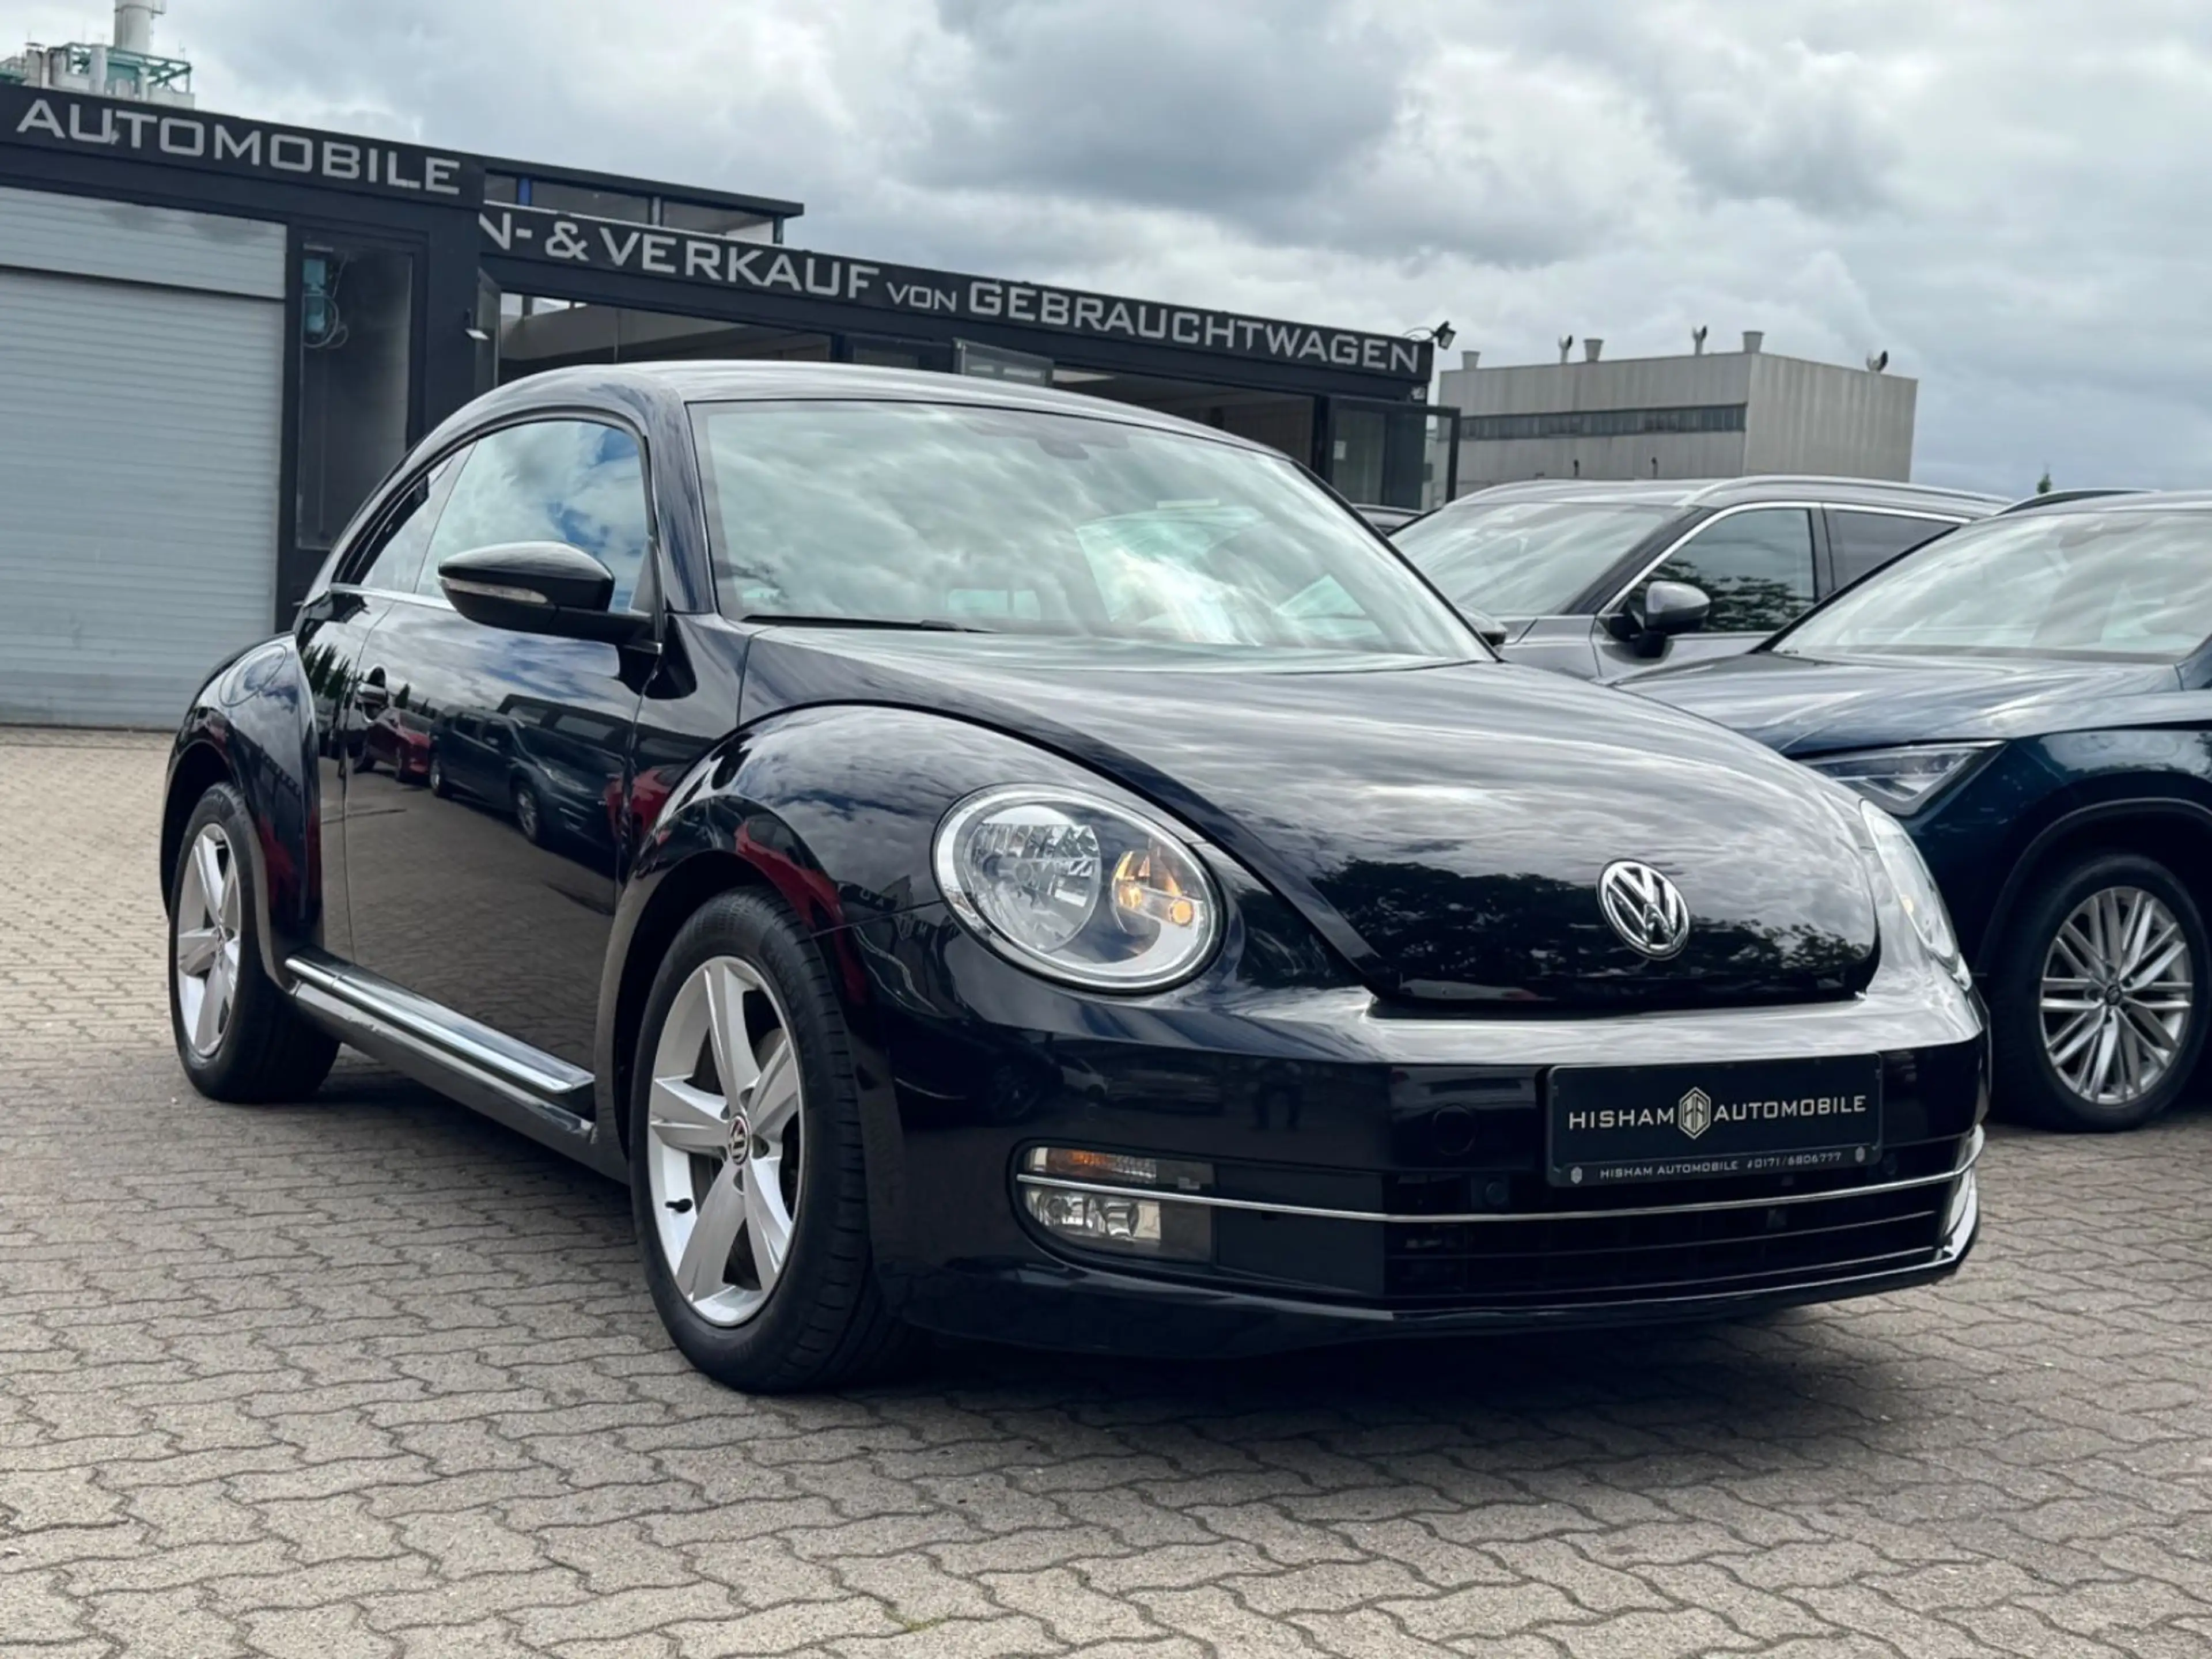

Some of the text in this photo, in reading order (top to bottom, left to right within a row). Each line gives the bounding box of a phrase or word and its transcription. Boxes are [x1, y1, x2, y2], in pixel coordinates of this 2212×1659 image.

[17, 99, 460, 194] AUTOMOBILE
[545, 221, 590, 262] &
[599, 226, 879, 298] VERKAUF
[887, 282, 957, 312] VON
[969, 281, 1419, 373] GEBRAUCHTWAGEN
[1569, 1107, 1674, 1130] HISHAM
[1713, 1096, 1866, 1122] AUTOMOBILE
[1600, 1166, 1653, 1179] HISHAM
[1657, 1160, 1738, 1175] AUTOMOBILE
